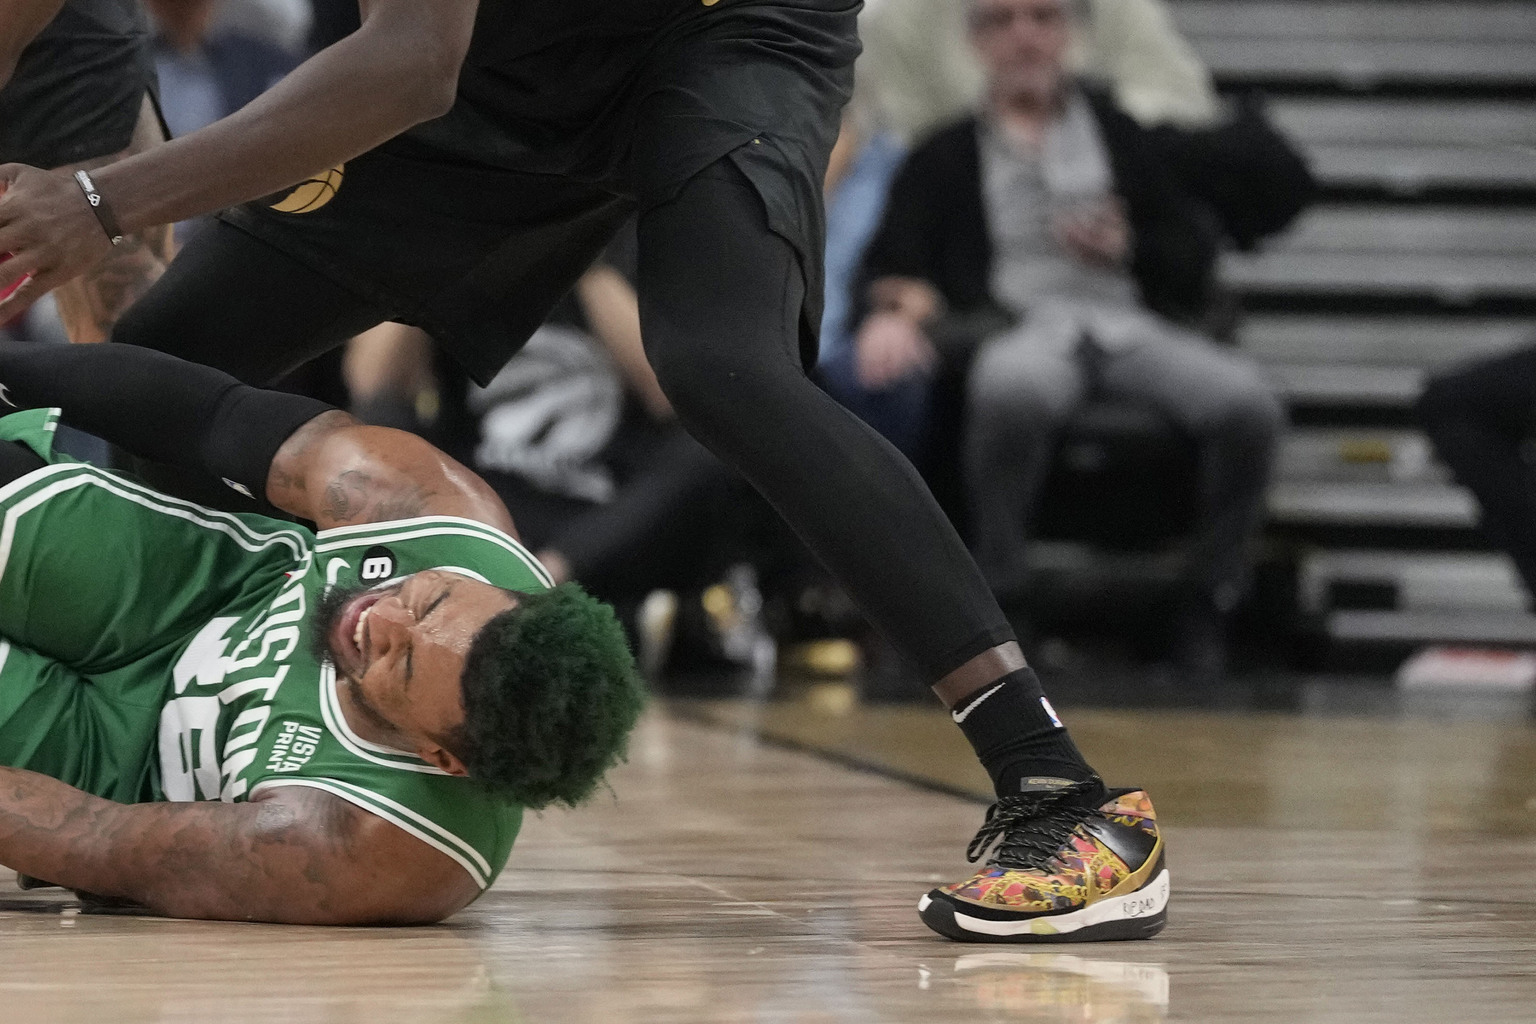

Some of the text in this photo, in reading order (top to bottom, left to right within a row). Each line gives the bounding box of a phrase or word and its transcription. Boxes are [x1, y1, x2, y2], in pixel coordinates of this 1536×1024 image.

[361, 556, 393, 580] 6
[266, 720, 301, 772] PRINT
[277, 724, 323, 773] VISTA
